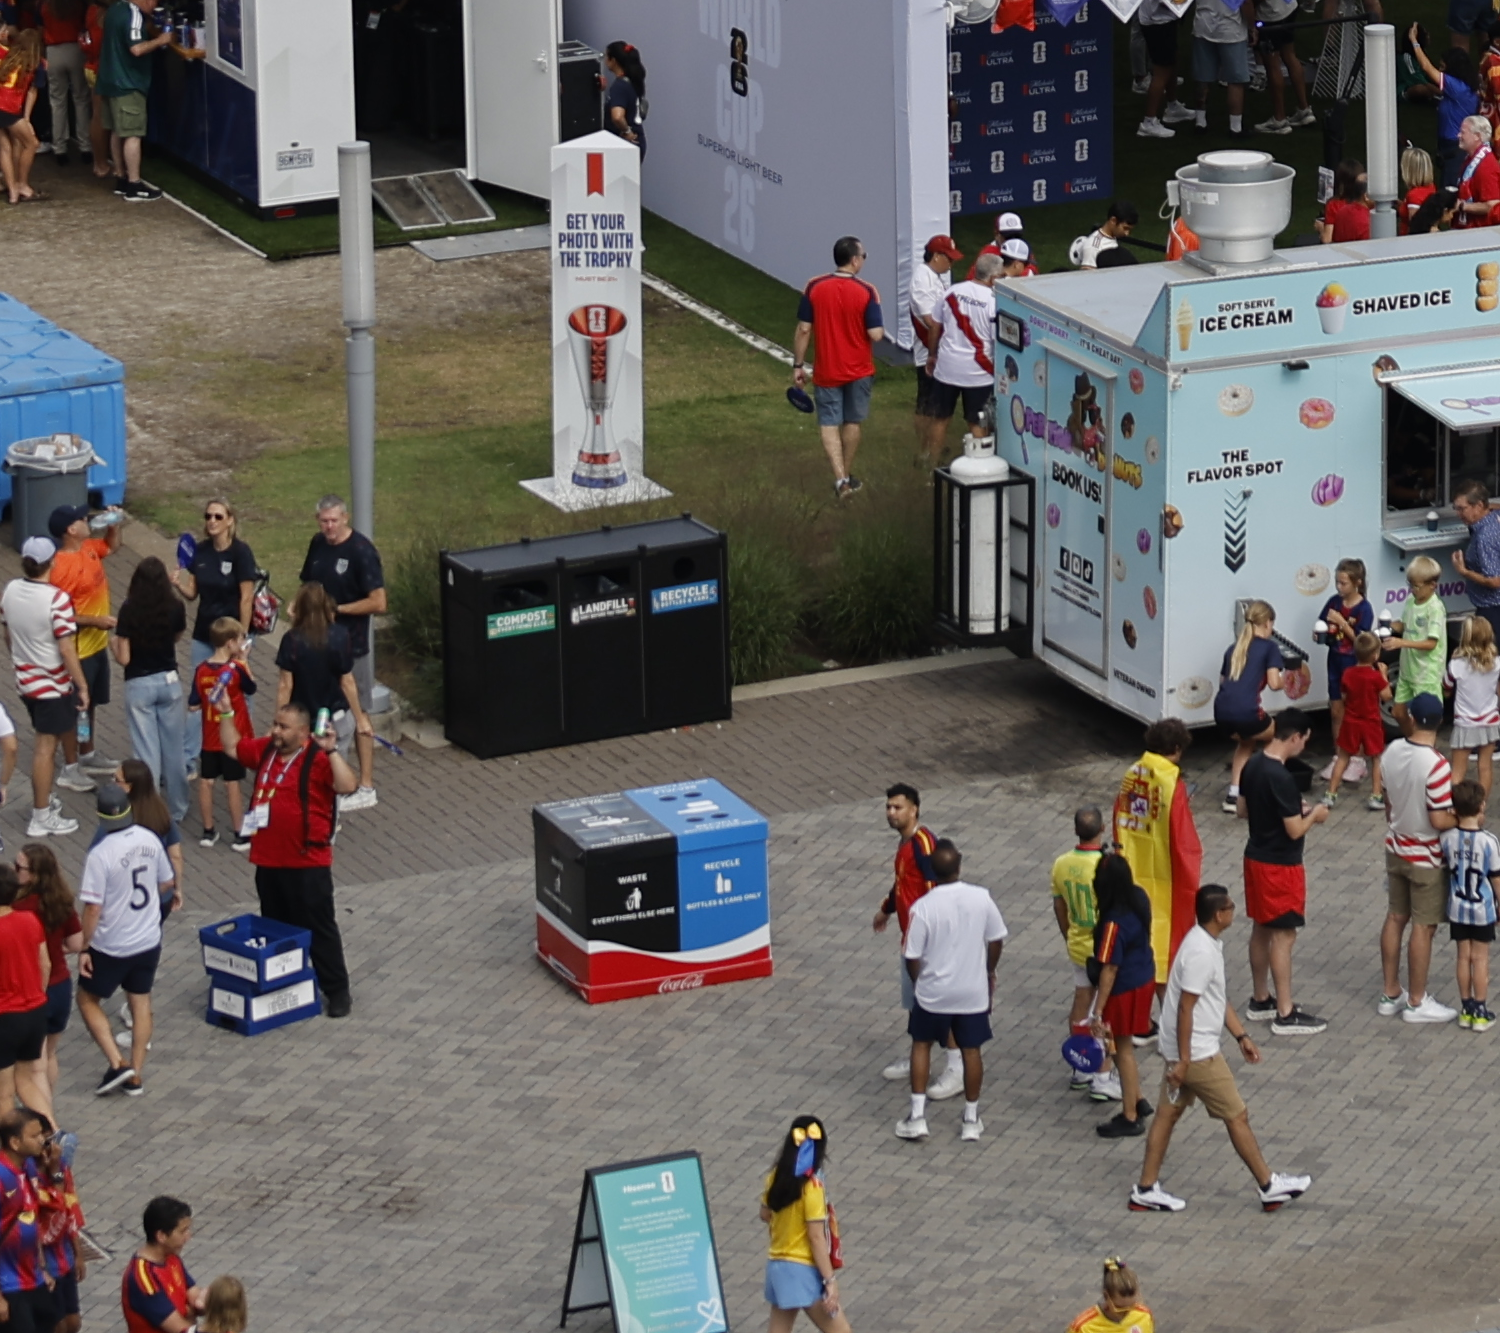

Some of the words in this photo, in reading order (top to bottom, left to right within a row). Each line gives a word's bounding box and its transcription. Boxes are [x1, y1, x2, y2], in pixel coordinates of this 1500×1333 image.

[697, 134, 737, 166] SUPERIOR
[737, 150, 761, 176] LIGHT
[761, 162, 784, 186] BEER
[566, 213, 588, 230] GET
[591, 213, 625, 230] YOUR
[558, 232, 598, 249] PHOTO
[602, 232, 634, 249] WITH
[560, 250, 582, 268] THE
[584, 250, 633, 269] TROPHY
[1218, 301, 1243, 312] SOFT
[1244, 298, 1275, 310] SERVE
[1352, 292, 1421, 316] SHAVED
[1424, 289, 1452, 308] ICE
[1200, 314, 1231, 333] ICE
[1235, 309, 1293, 331] CREAM
[1222, 449, 1249, 464] THE
[1187, 466, 1243, 484] FLAVOR
[1245, 460, 1283, 477] SPOT
[1052, 461, 1082, 492] BOOK
[1083, 479, 1103, 504] US!
[659, 585, 710, 602] RECYCLE
[578, 599, 629, 616] LANDFILL
[495, 611, 548, 627] COMPOST
[704, 858, 740, 871] RECYCLE
[618, 873, 648, 885] WASTE
[130, 865, 149, 911] 5
[592, 912, 637, 926] EVERYTHING
[638, 909, 655, 920] ELSE
[656, 906, 675, 916] HERE
